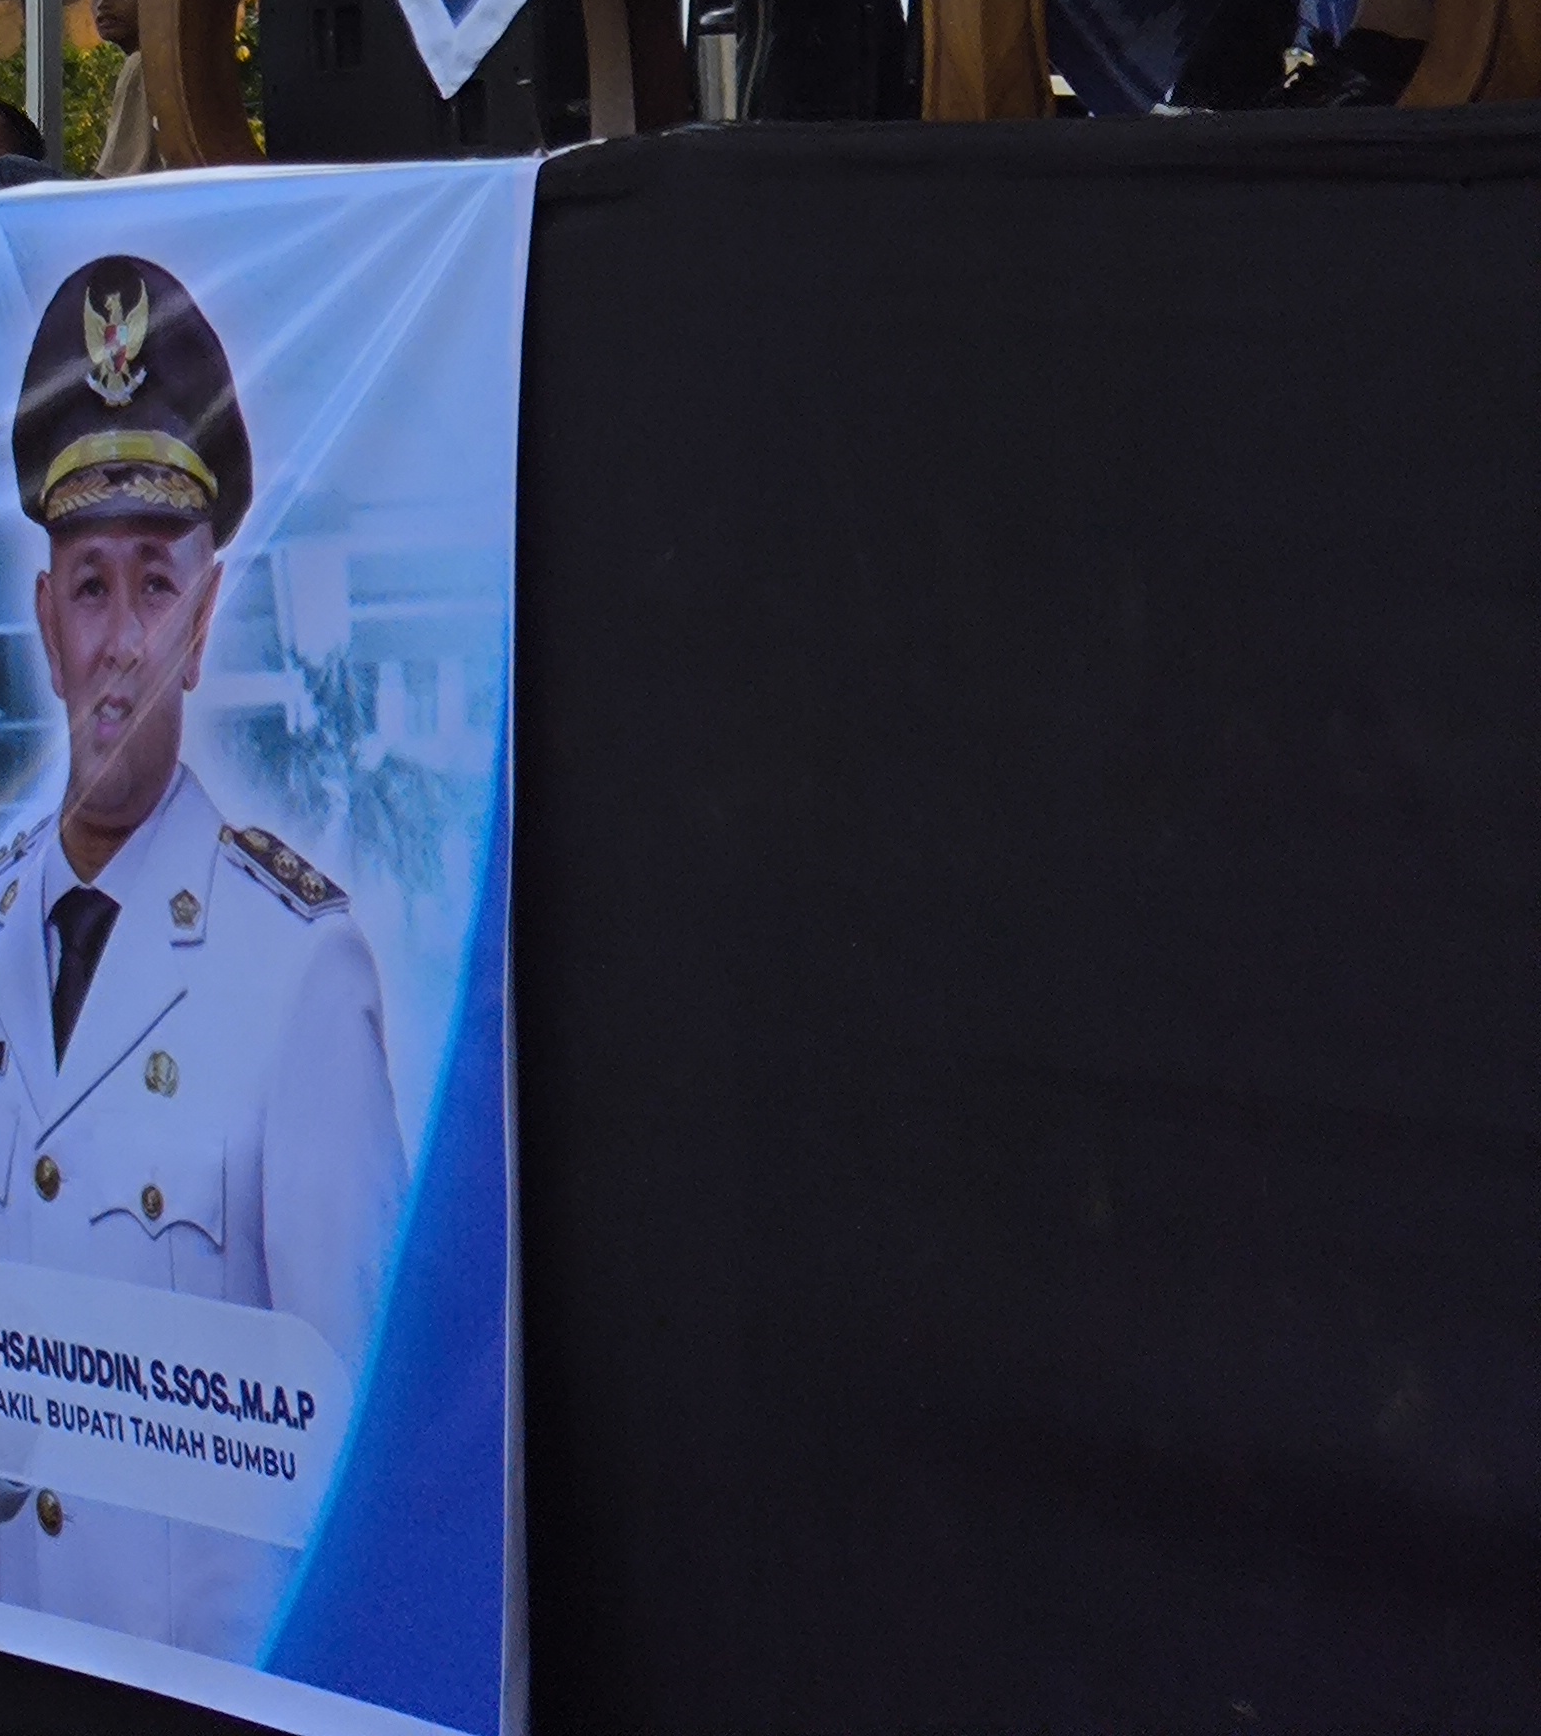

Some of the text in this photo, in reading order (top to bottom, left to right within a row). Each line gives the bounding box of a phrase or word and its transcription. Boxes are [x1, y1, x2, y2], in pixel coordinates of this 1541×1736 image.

[47, 1398, 126, 1443] BUPATI
[130, 1415, 207, 1461] TANAH
[212, 1434, 297, 1482] BUMBU
